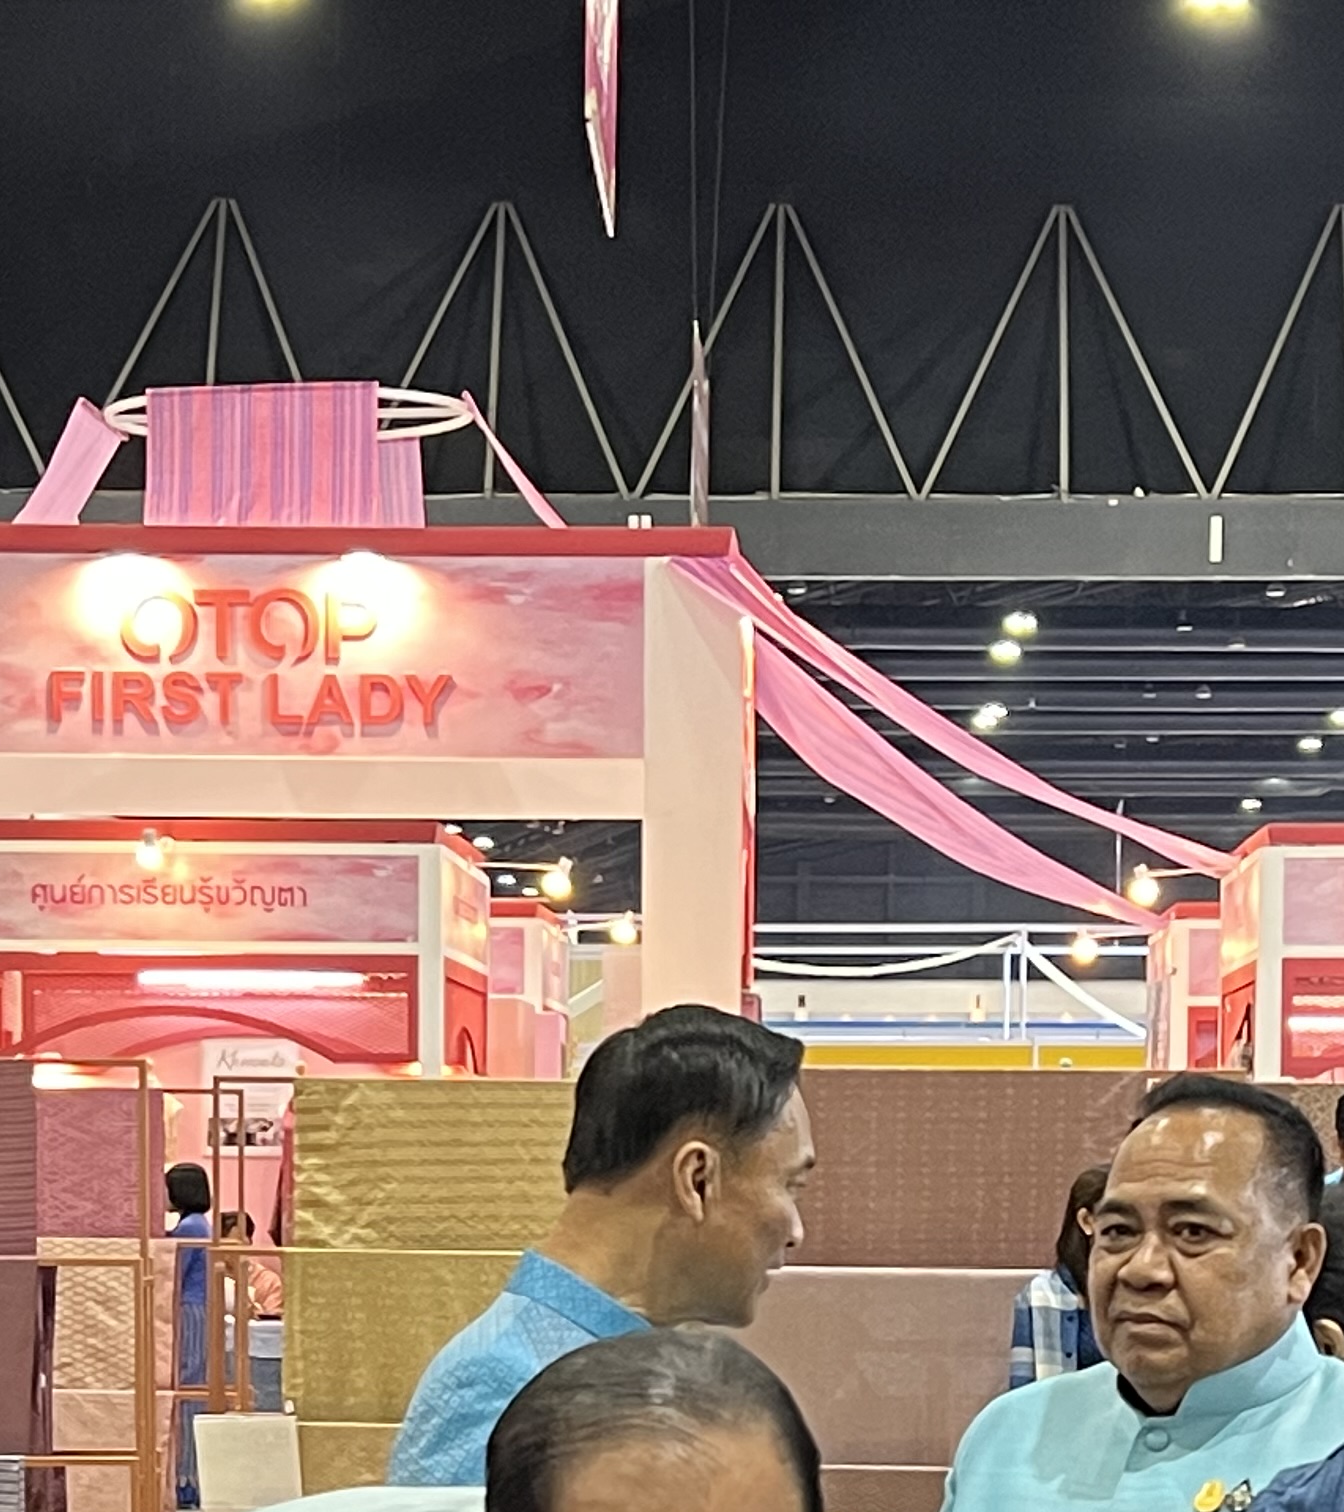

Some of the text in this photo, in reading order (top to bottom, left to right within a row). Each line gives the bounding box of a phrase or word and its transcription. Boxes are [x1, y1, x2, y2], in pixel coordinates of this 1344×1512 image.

[119, 588, 378, 666] OTOP
[47, 670, 456, 737] FIRST LADY
[31, 874, 308, 914] ศูนย์การเรียนรู้ขวัญตา
